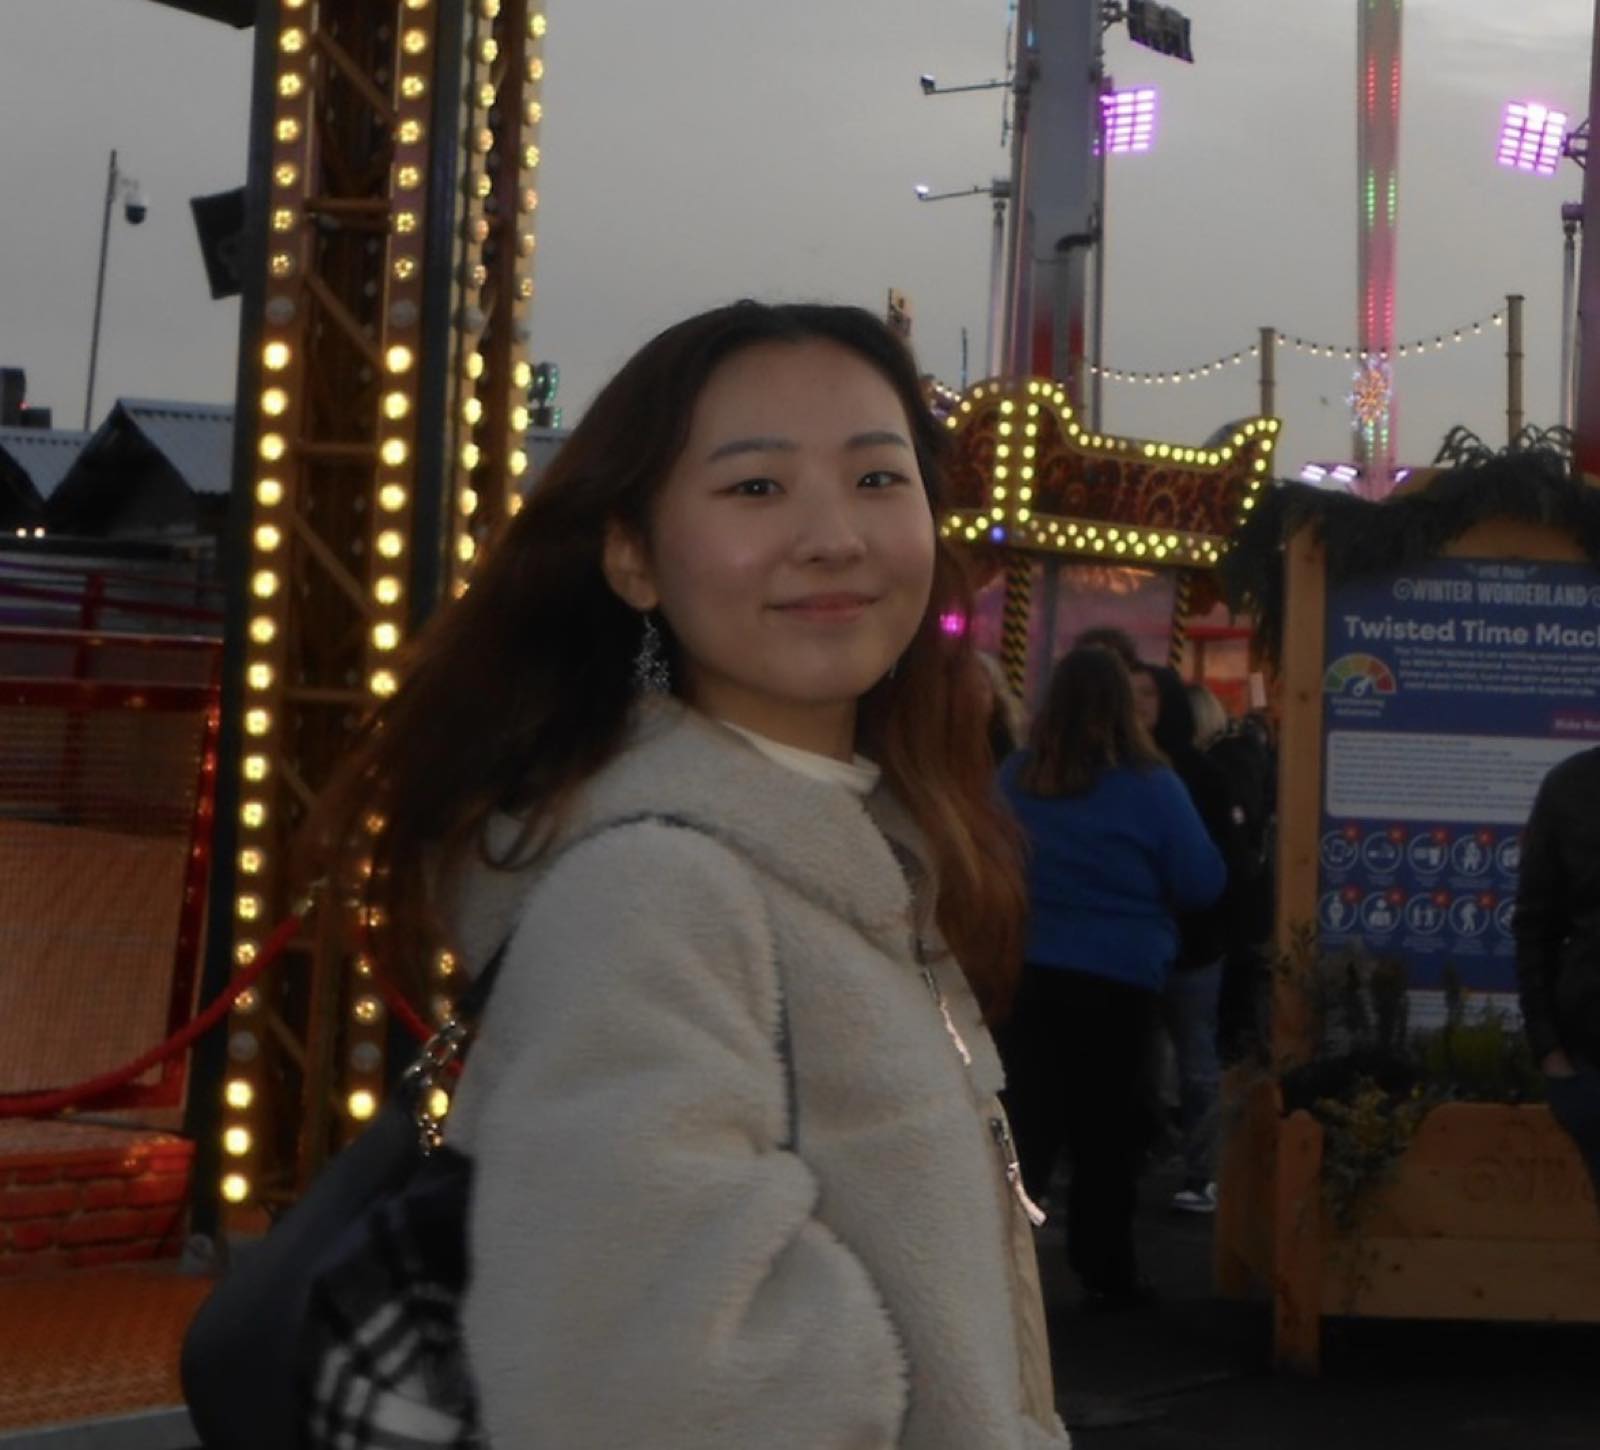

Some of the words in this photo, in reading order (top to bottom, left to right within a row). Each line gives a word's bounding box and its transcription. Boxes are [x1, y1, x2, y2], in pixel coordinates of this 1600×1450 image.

[1412, 580, 1473, 603] WINTER
[1477, 582, 1588, 608] WONDERLAND
[1343, 614, 1456, 642] Twisted
[1461, 619, 1529, 645] Time
[1535, 622, 1600, 648] Mac
